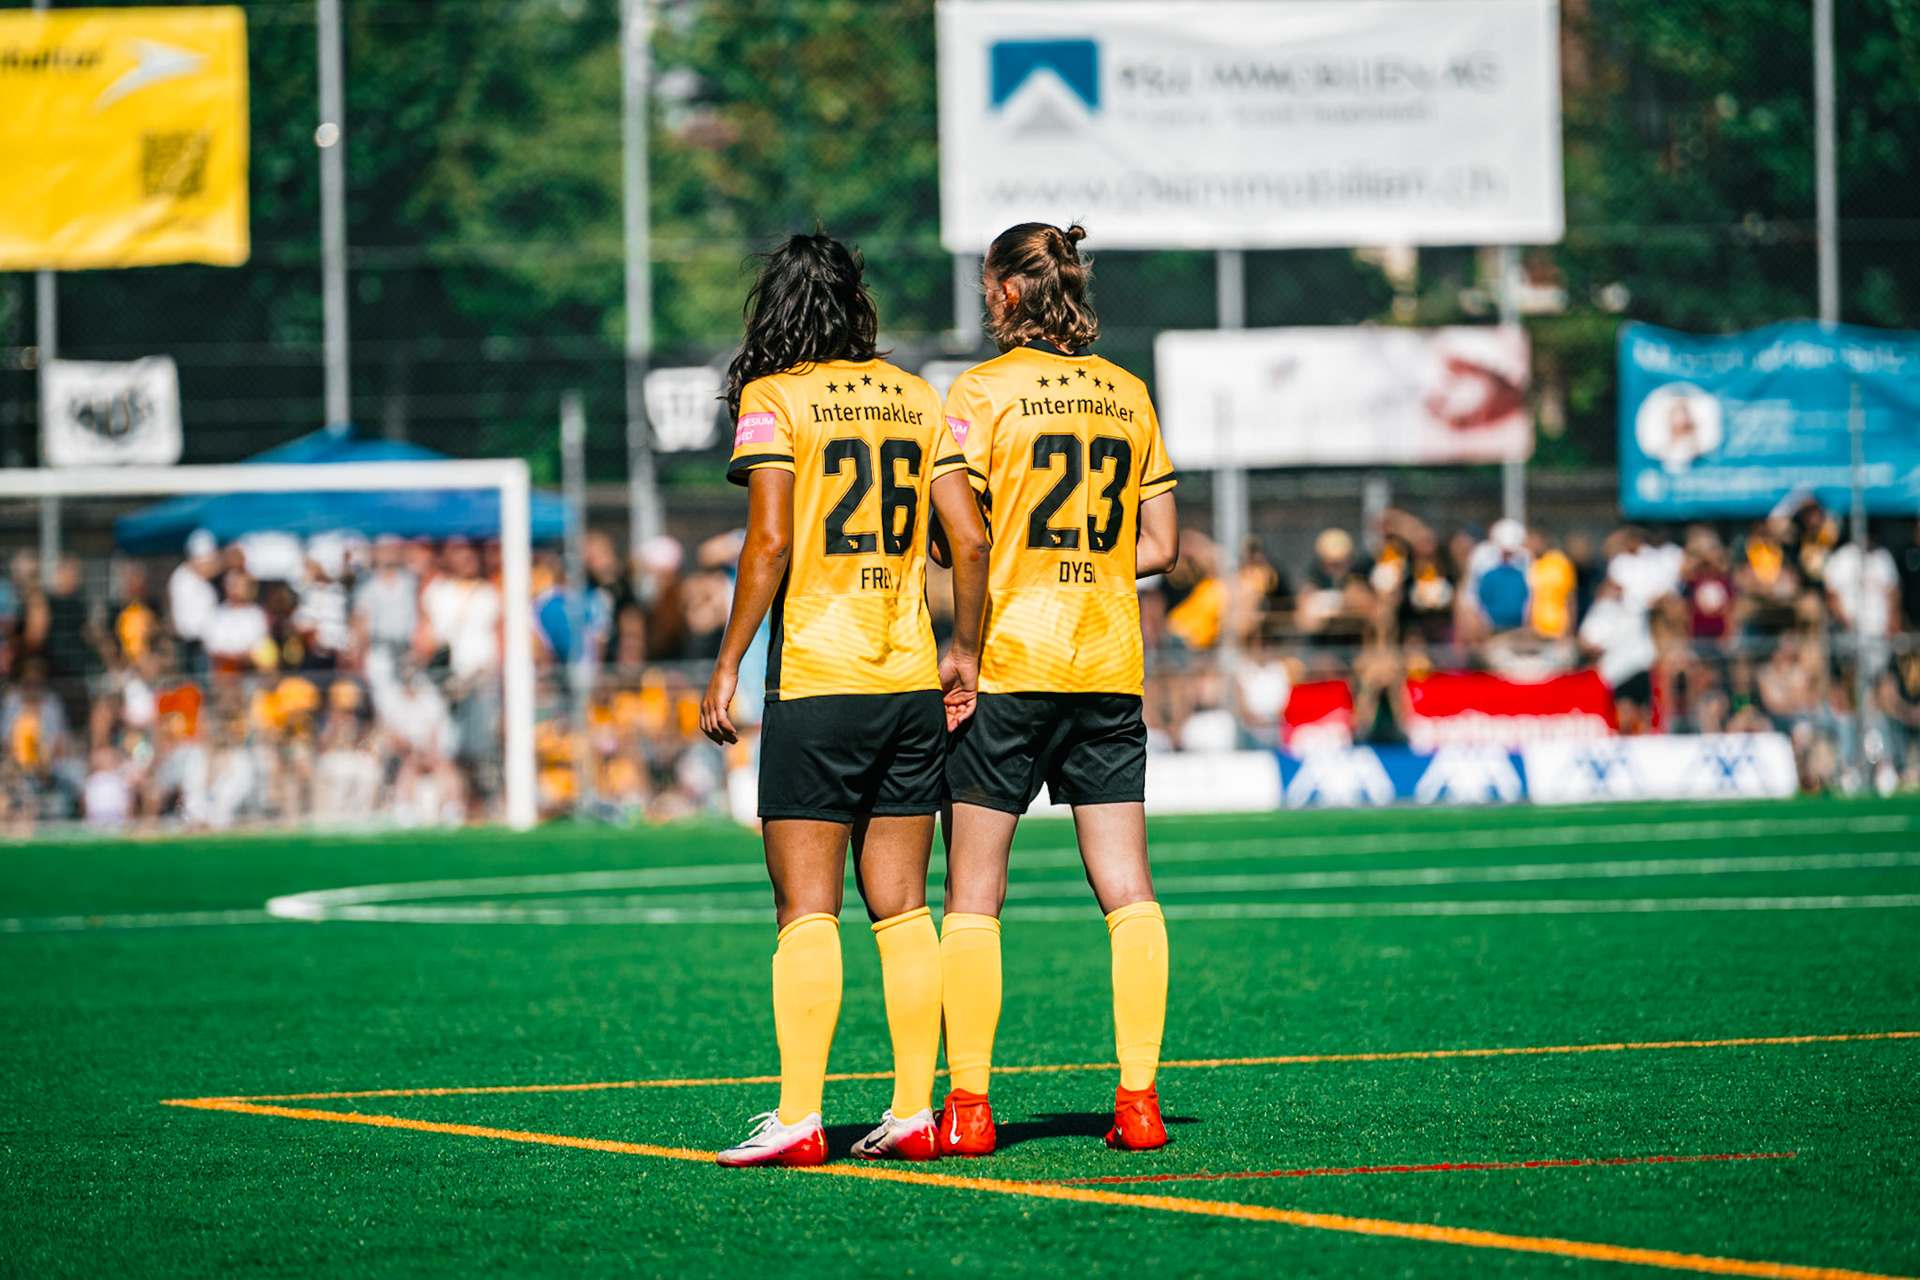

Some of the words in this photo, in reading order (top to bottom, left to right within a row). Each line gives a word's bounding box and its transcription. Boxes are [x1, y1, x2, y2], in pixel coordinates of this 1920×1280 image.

[811, 403, 923, 425] Intermakler
[1020, 398, 1134, 422] Intermakler
[823, 436, 922, 556] 26
[1026, 432, 1131, 553] 23
[1060, 561, 1096, 583] DYS
